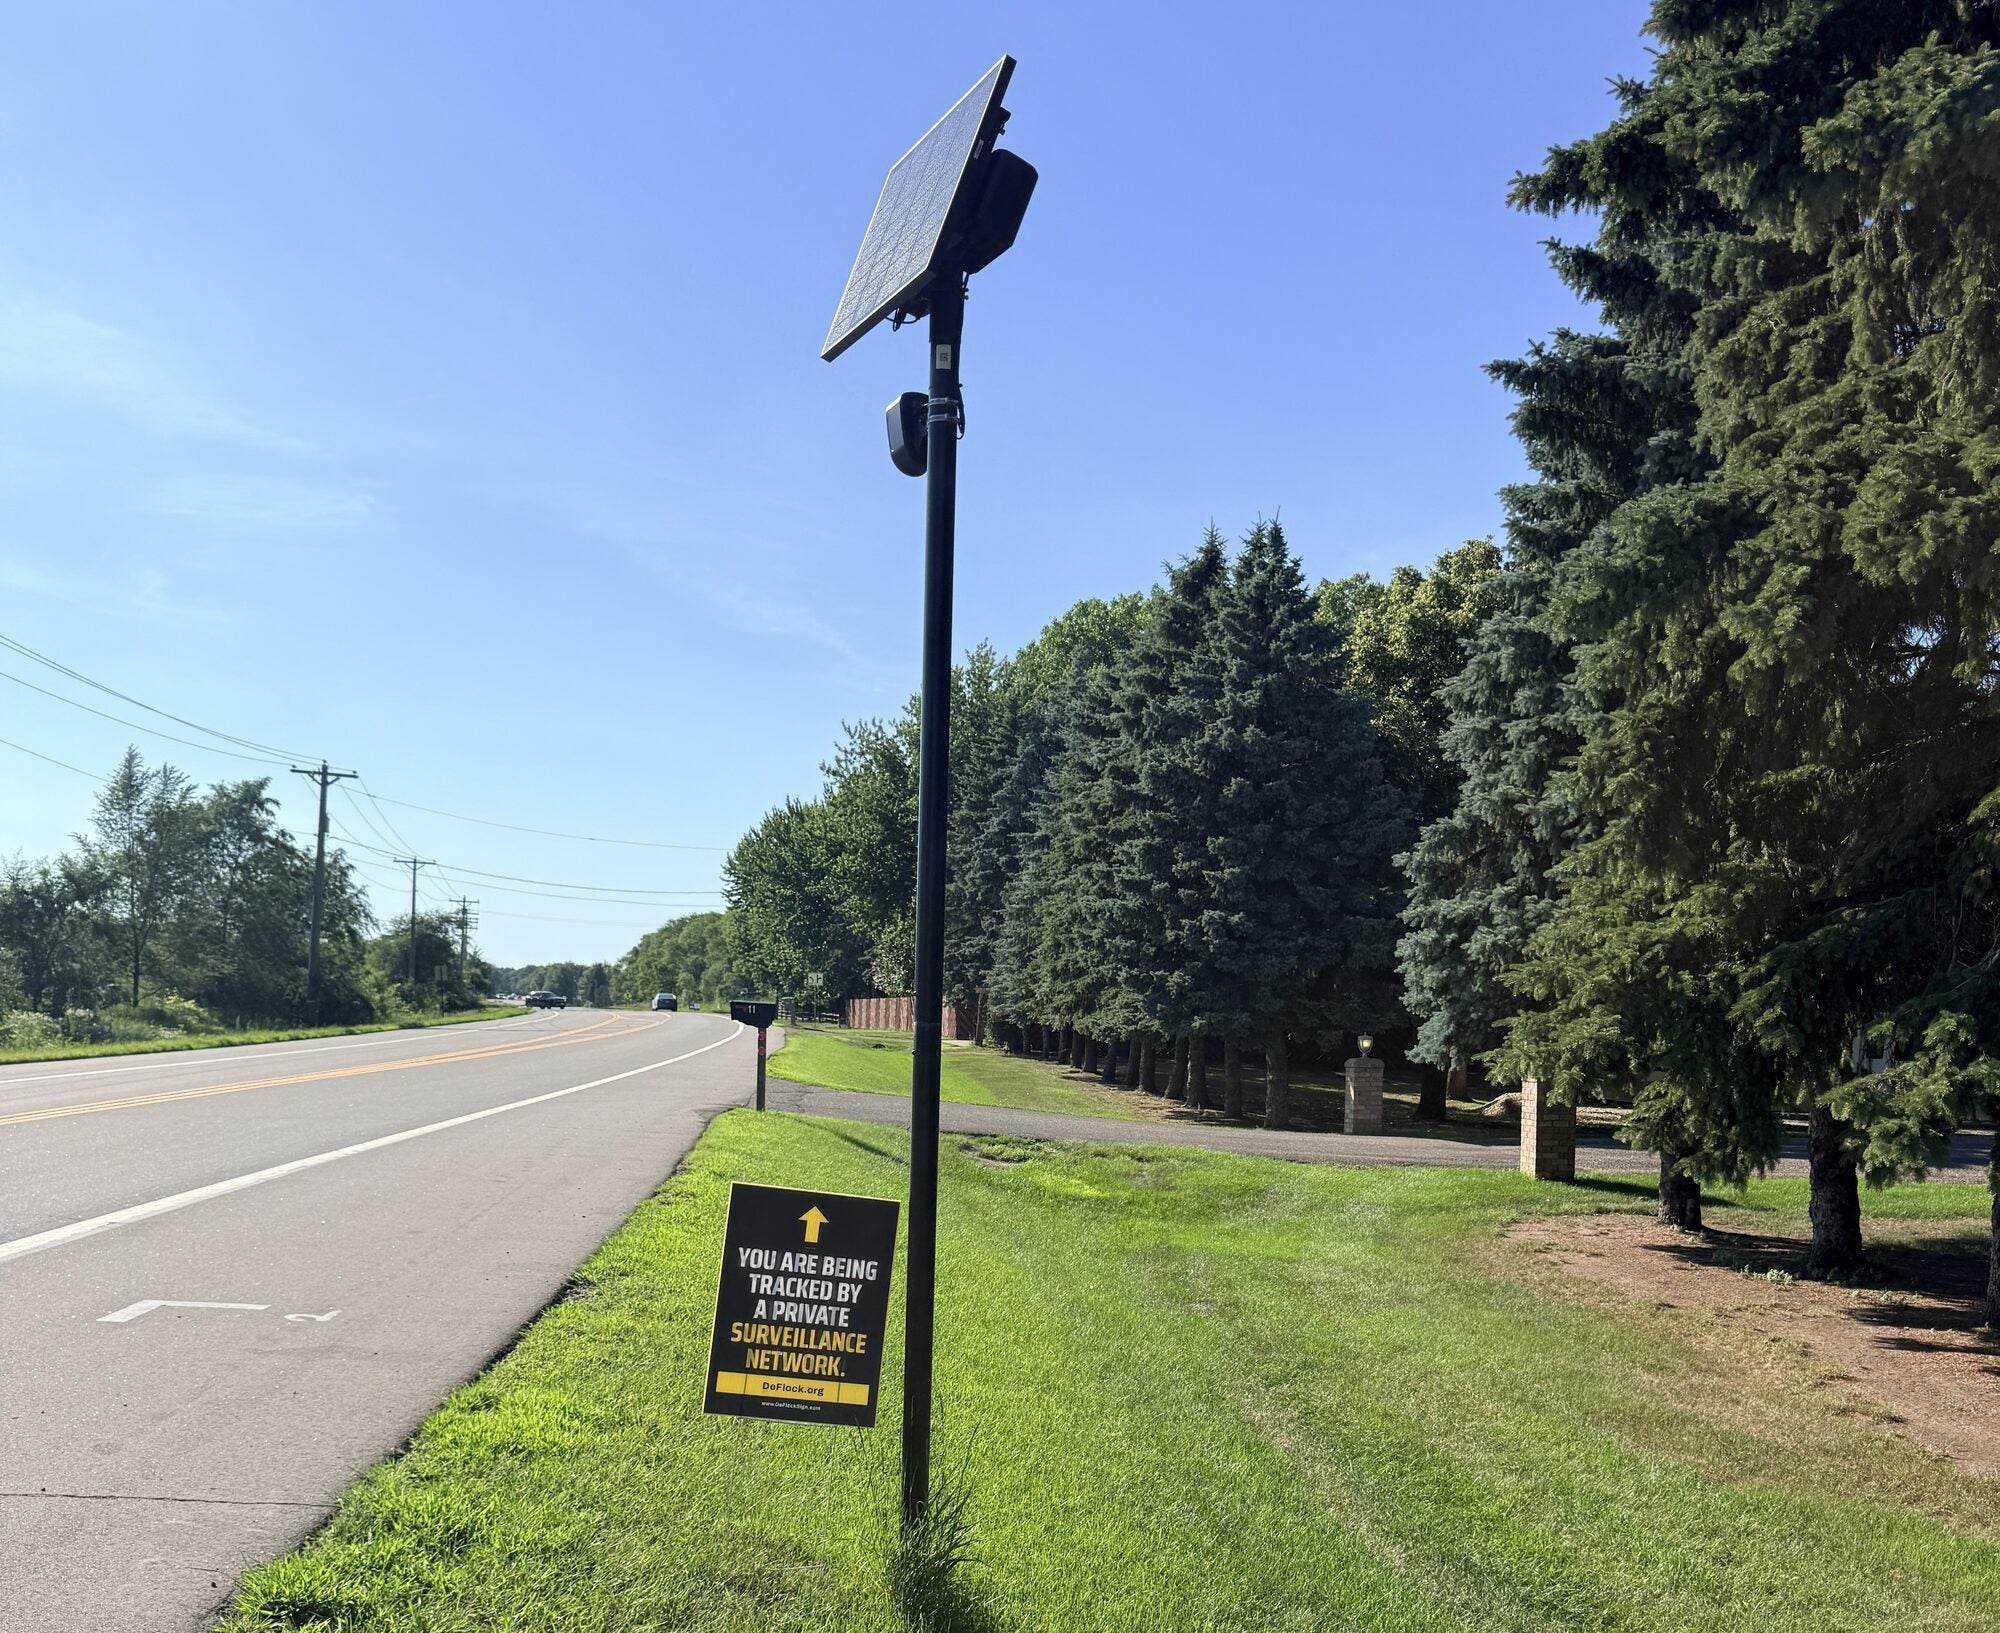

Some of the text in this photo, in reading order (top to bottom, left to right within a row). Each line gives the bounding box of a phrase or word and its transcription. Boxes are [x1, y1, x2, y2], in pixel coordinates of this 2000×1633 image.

[748, 1005, 756, 1013] 11
[738, 1246, 878, 1281] YOU ARE BEING
[749, 1273, 863, 1304] TRACKED BY
[753, 1299, 850, 1327] A PRIVATE
[730, 1322, 867, 1354] SURVEILLANCE
[745, 1348, 846, 1377] NETWORK.
[762, 1381, 825, 1397] DeFlock.org
[761, 1401, 821, 1411] www.DeFlockSign.com
